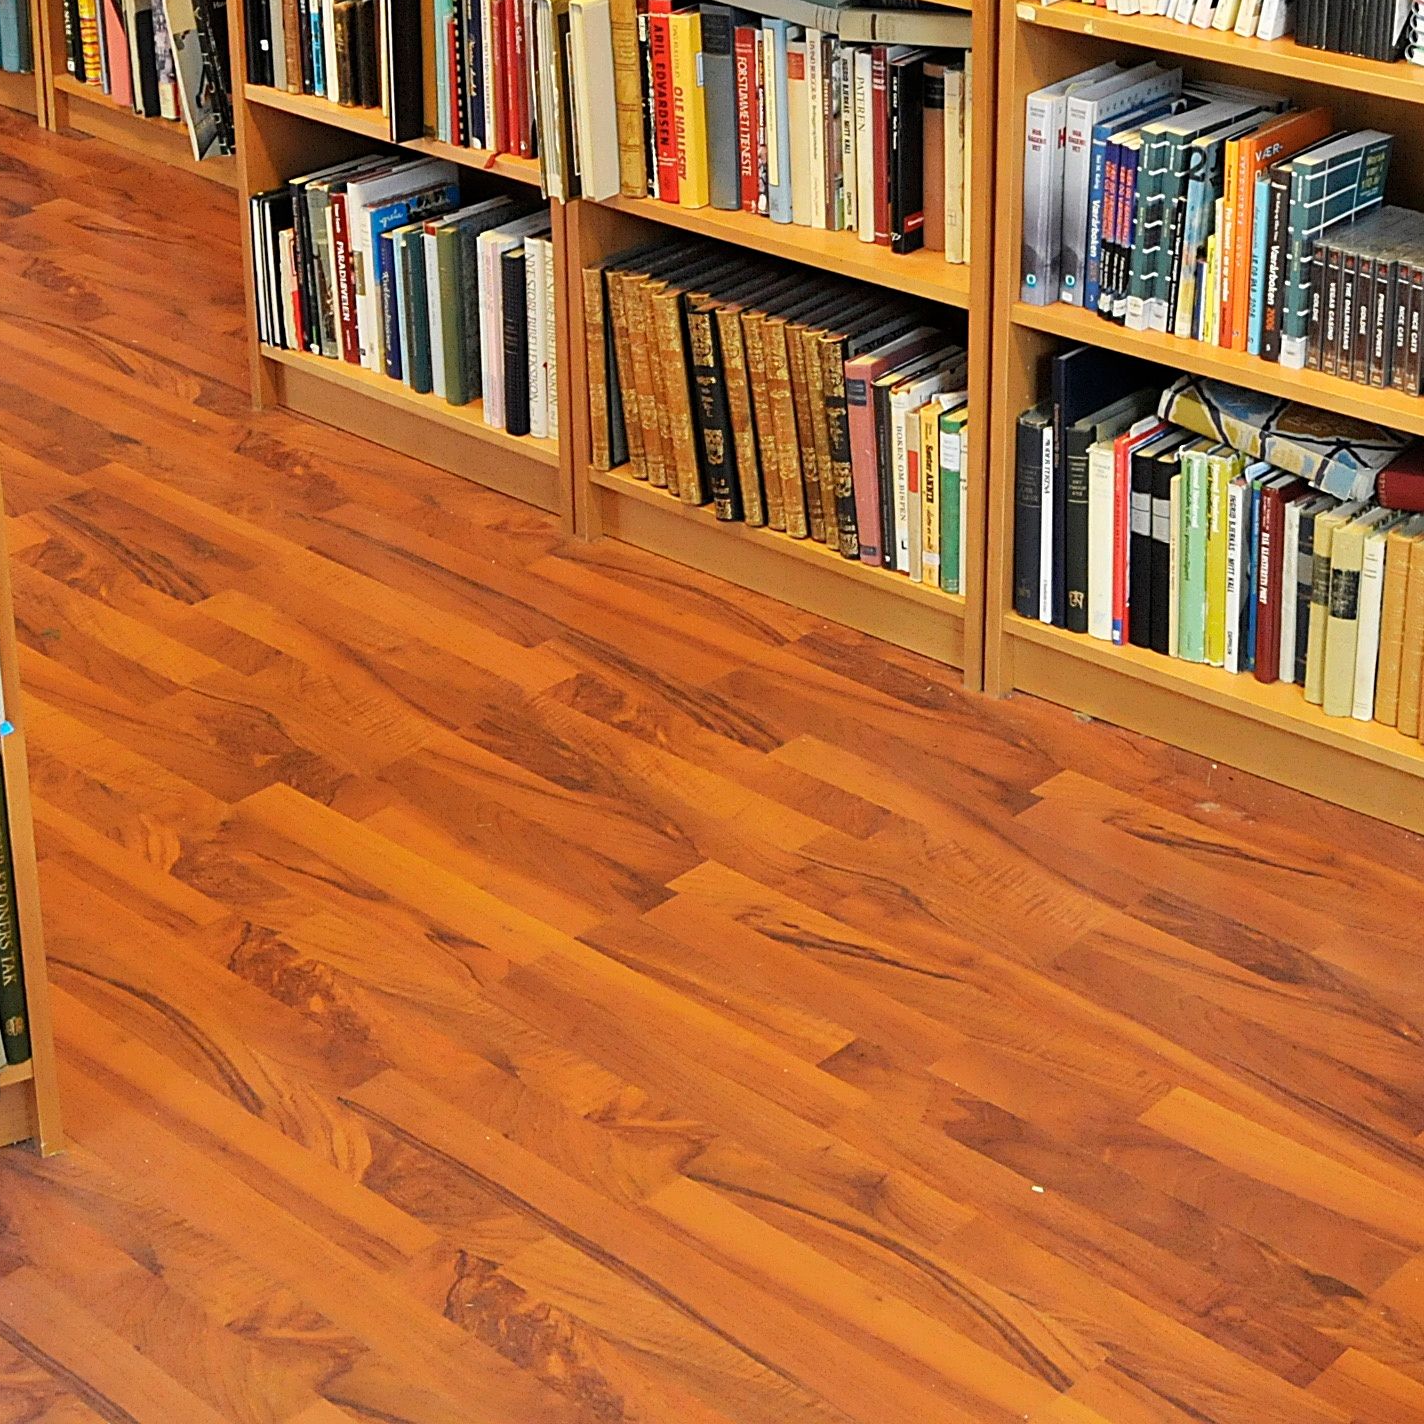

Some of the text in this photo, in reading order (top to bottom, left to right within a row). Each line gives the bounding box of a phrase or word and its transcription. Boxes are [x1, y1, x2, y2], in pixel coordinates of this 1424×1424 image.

[651, 24, 669, 145] ARIL EDVARDSEN
[855, 76, 865, 131] PATEREN
[672, 85, 687, 179] OLE HALLESBY
[894, 426, 905, 520] BOKEN OM BISPEN
[0, 953, 18, 985] TAK
